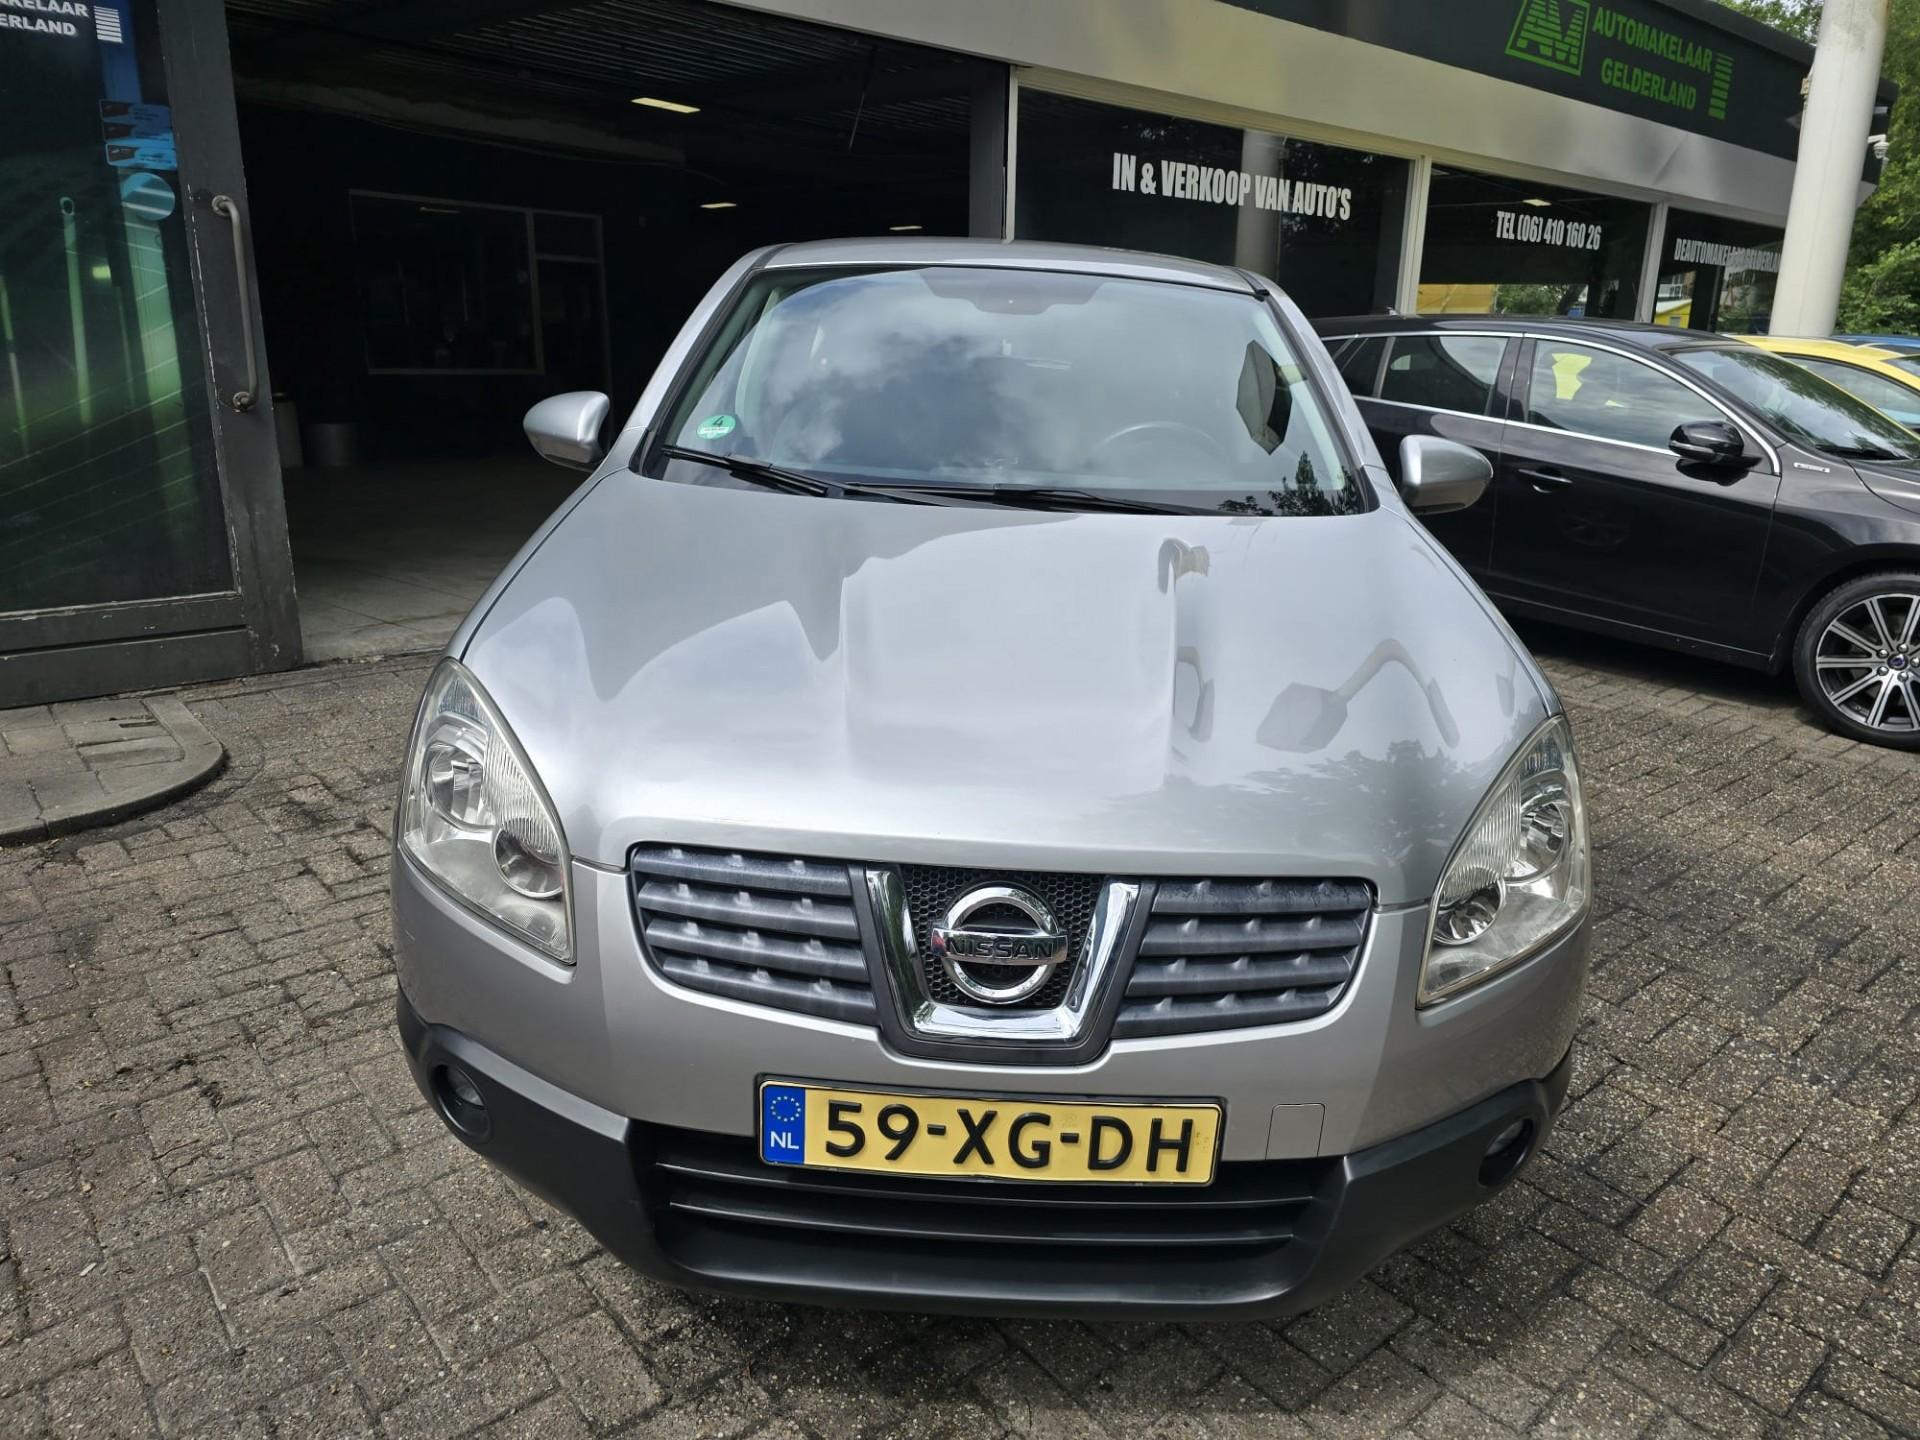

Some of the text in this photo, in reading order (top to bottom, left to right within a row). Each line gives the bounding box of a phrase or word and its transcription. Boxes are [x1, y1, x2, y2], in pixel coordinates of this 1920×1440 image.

[1592, 7, 1713, 73] AUTOMAKELAAR
[1601, 57, 1698, 111] GELDERLAND
[1112, 152, 1352, 221] IN & VERKOOP VAN AUTO'S
[1496, 210, 1602, 250] TEL (06) 410 160 26
[712, 415, 725, 428] 4
[947, 937, 1053, 959] NISSAN
[769, 1098, 1193, 1173] NL 59-XG-DH
